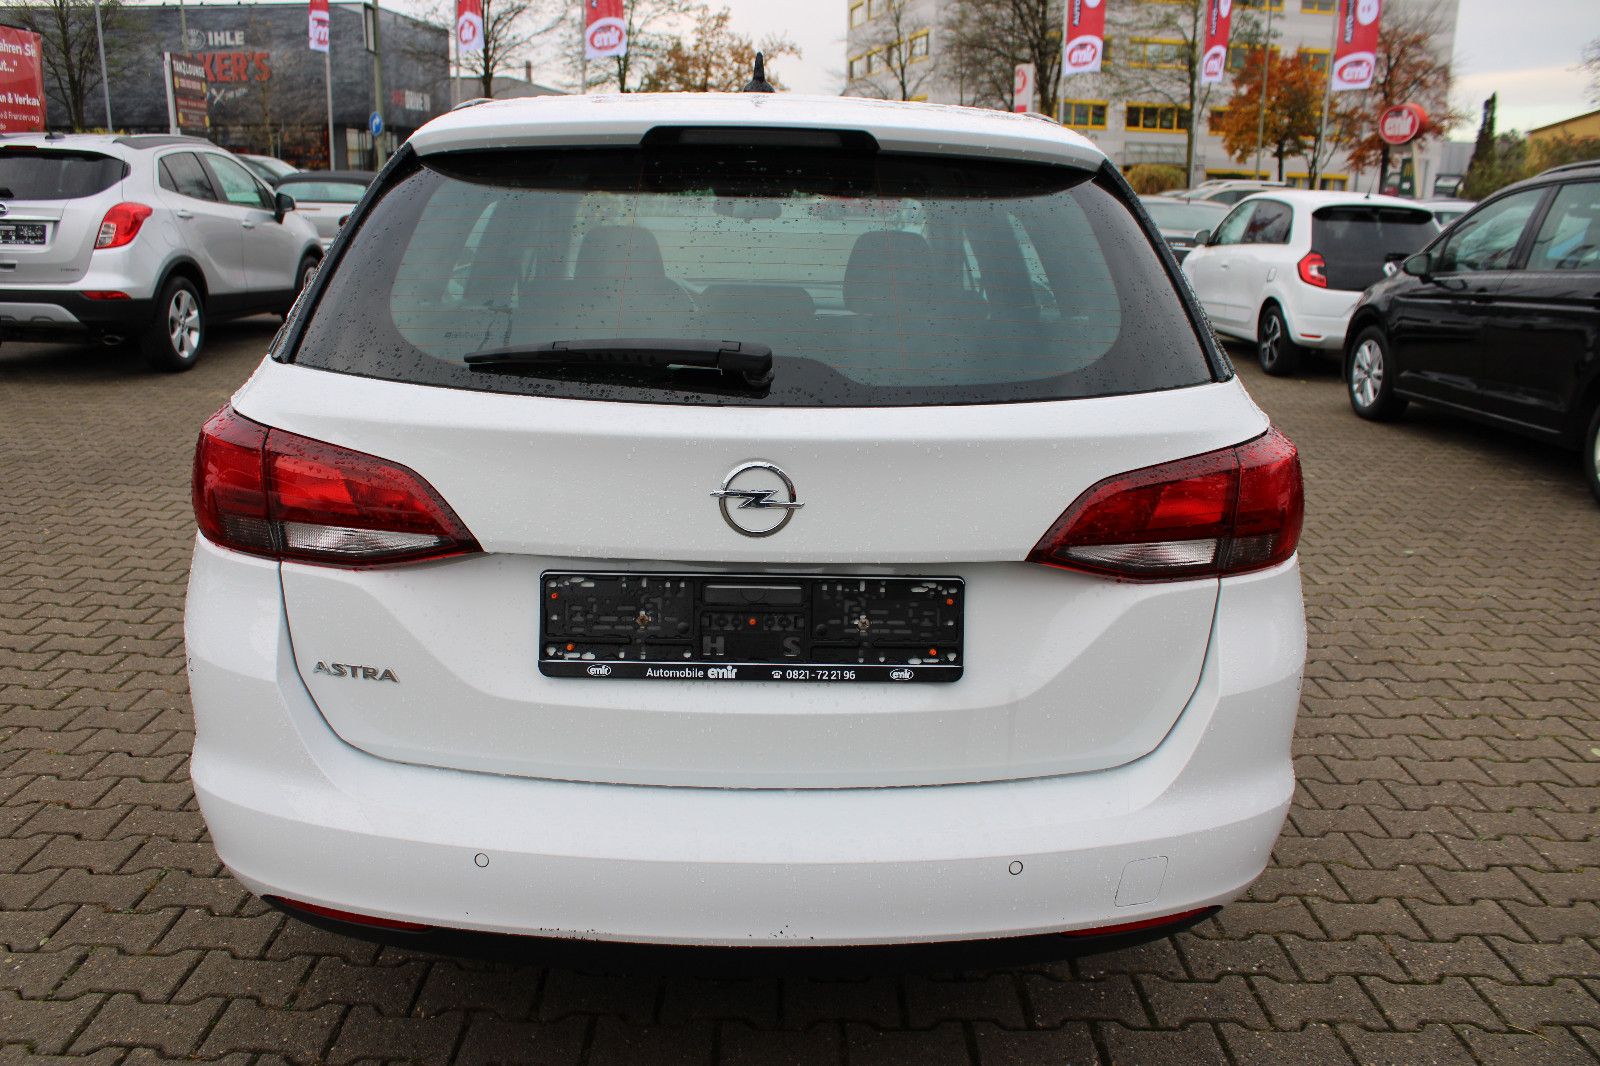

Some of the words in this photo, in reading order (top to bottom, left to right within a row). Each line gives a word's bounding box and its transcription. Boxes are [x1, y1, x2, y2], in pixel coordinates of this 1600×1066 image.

[208, 31, 245, 46] IHLE
[313, 660, 400, 683] ASTRA
[646, 667, 704, 678] Automobile
[707, 665, 738, 679] emir
